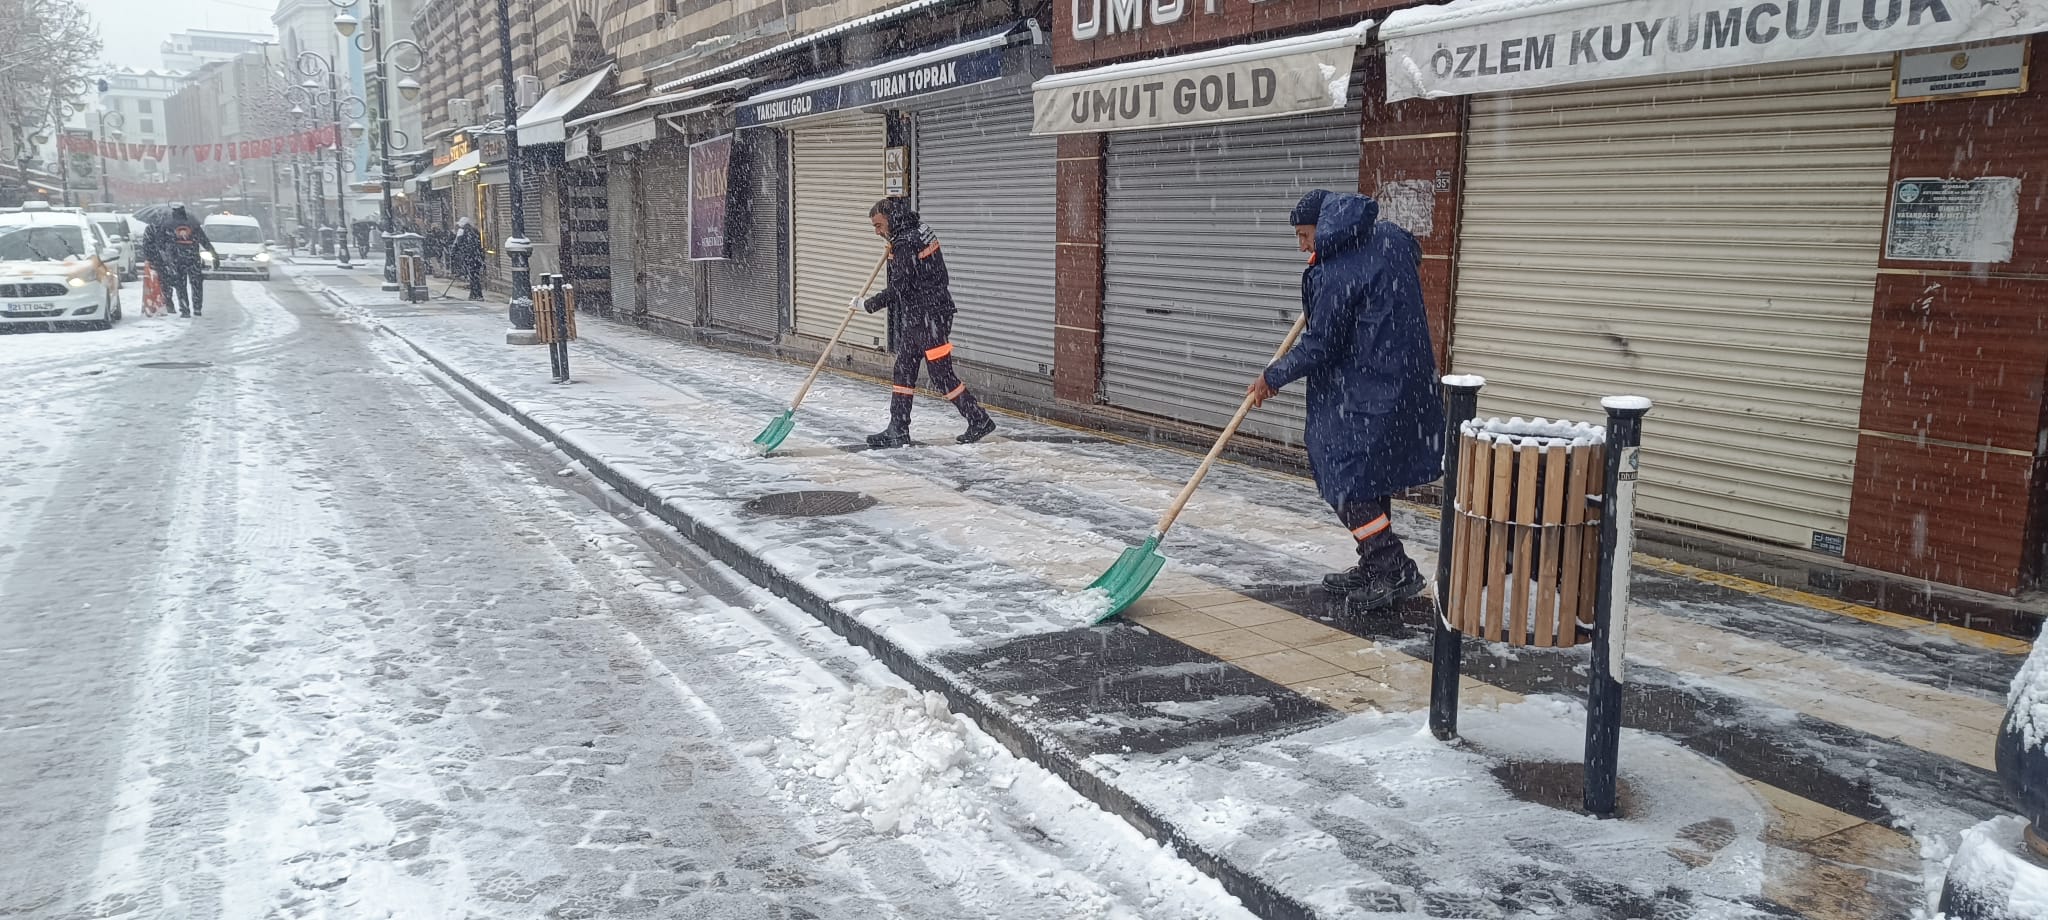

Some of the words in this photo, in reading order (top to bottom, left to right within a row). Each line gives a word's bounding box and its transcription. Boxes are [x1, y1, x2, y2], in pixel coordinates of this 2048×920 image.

[1072, 0, 1216, 41] UMU
[1430, 33, 1554, 80] ÖZLEM
[1568, 0, 1953, 66] KUYUMCULUK
[870, 77, 906, 99] TURAN
[908, 62, 956, 92] TOPRAK
[1071, 82, 1164, 124] UMUT
[1173, 67, 1277, 115] GOLD
[756, 101, 790, 121] YAKIŞIKLI
[791, 96, 812, 116] GOLD
